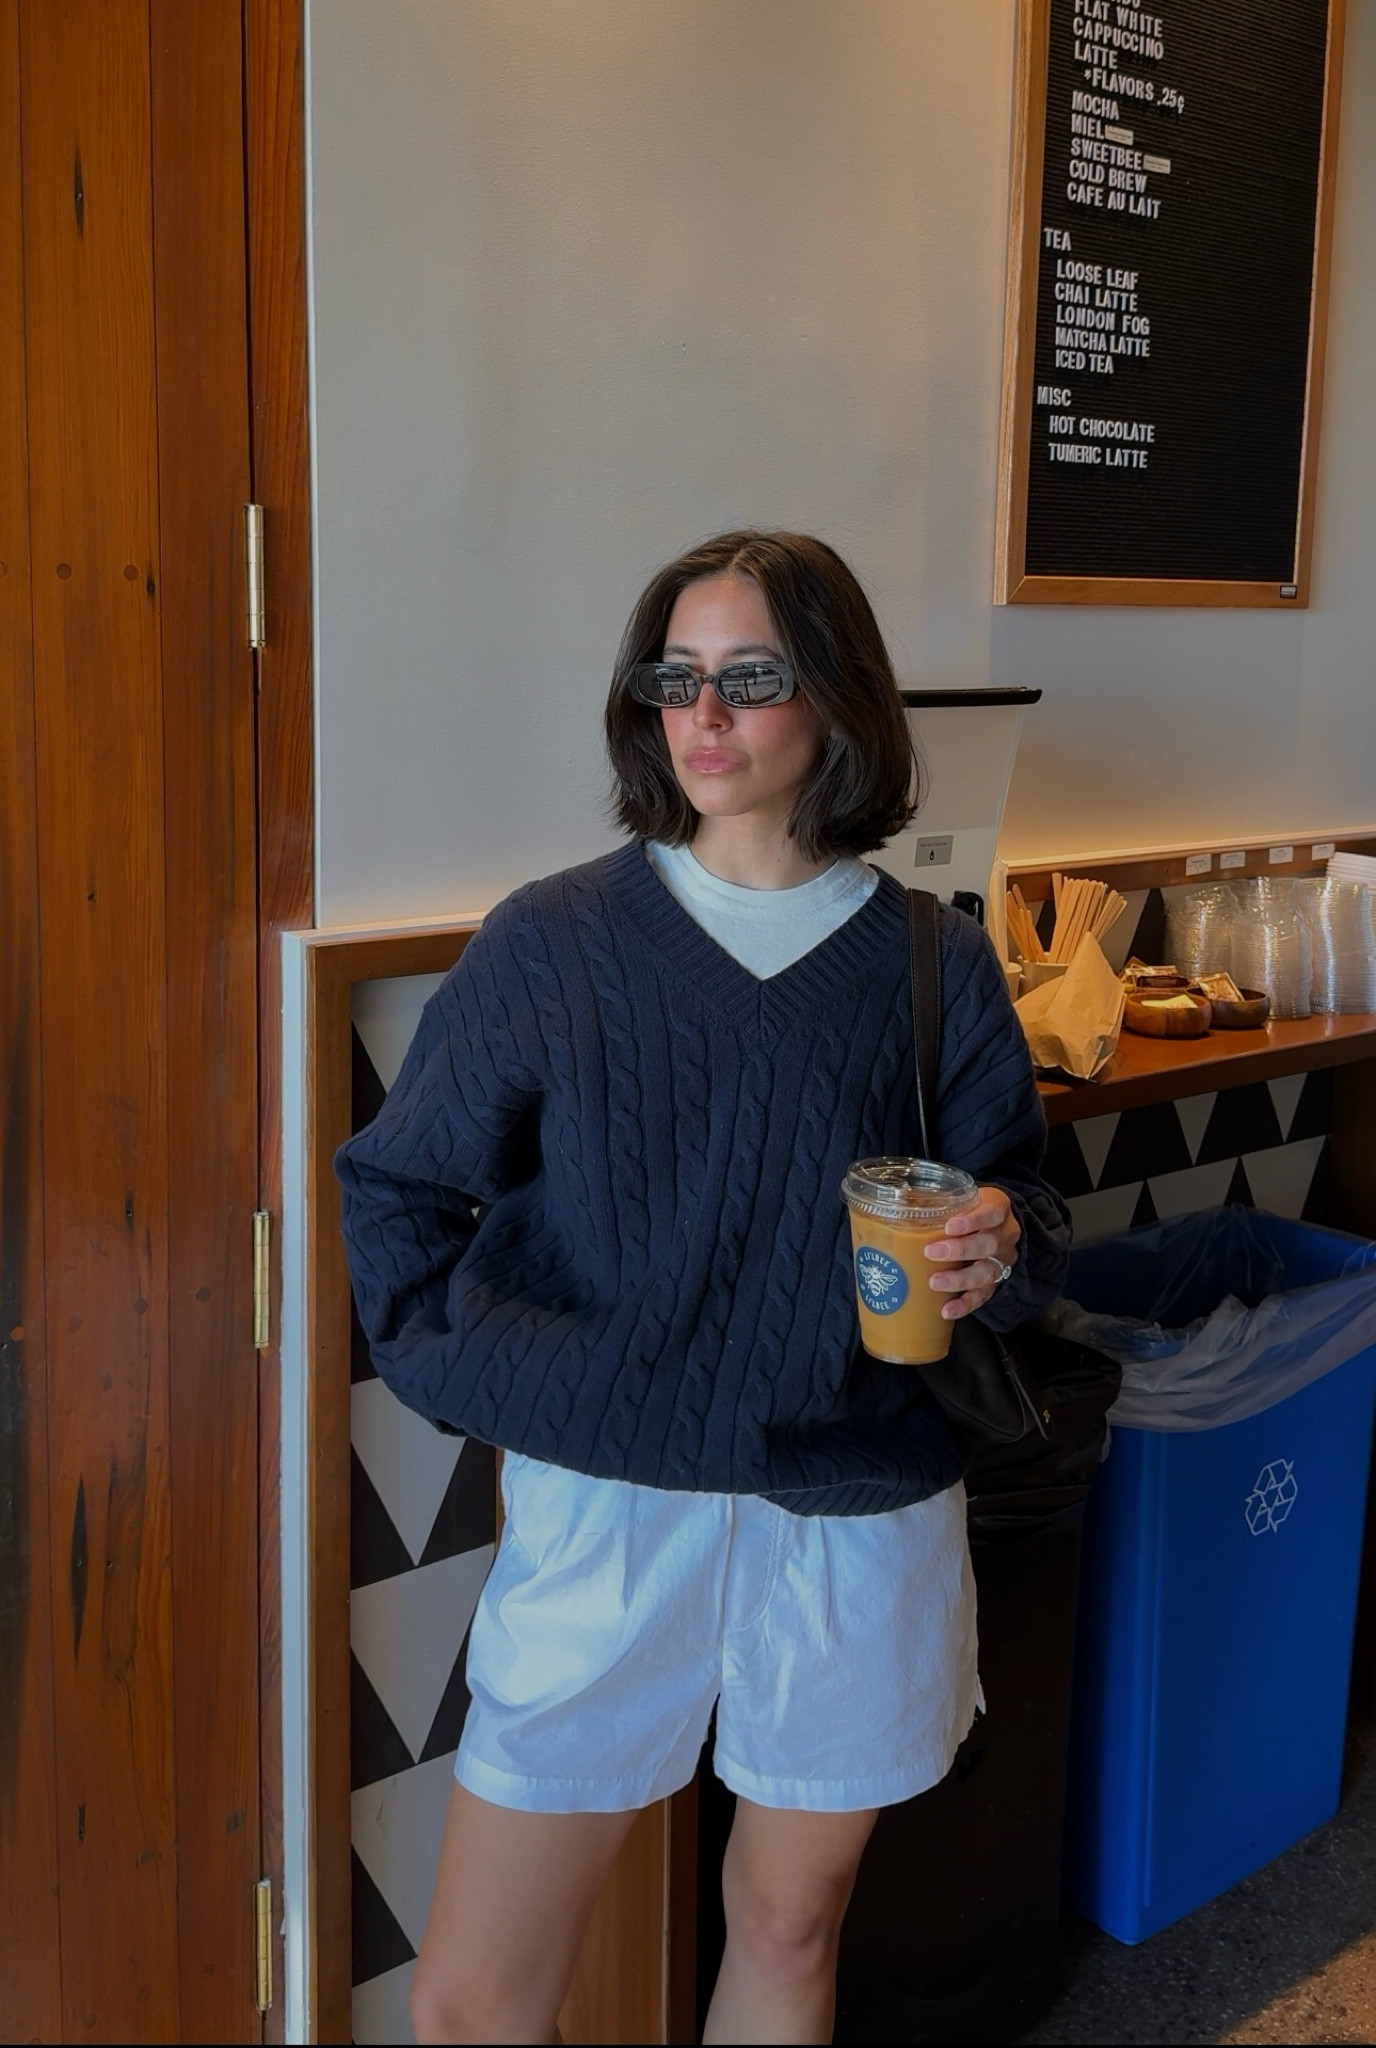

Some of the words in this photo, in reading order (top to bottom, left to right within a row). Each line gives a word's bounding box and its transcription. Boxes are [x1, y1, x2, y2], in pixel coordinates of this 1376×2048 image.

[1075, 0, 1109, 21] FLAT
[1117, 6, 1162, 37] WHITE
[1073, 17, 1163, 59] CAPPUCCINO
[1075, 41, 1118, 70] LATTE
[1072, 91, 1119, 120] MOCHA
[1071, 114, 1104, 139] MIEL
[1071, 138, 1142, 170] SWEETBEE
[1069, 160, 1104, 183] COLD
[1109, 170, 1147, 193] BREW
[1067, 183, 1103, 207] CAFE
[1108, 191, 1125, 211] AU
[1129, 196, 1161, 219] LAIT
[1044, 228, 1071, 250] TEA
[1057, 259, 1102, 284] LOOSE
[1107, 268, 1138, 290] LEAF
[1055, 283, 1089, 303] CHAI
[1096, 289, 1138, 312] LATTE
[1057, 305, 1115, 331] LONDON
[1122, 315, 1150, 335] FOG
[1055, 327, 1107, 351] MATCHA
[1110, 334, 1150, 357] LATTE
[1055, 350, 1085, 370] ICED
[1089, 354, 1114, 373] TEA
[1037, 386, 1072, 407] MISC
[1049, 415, 1076, 434] HOT
[1079, 419, 1155, 443] CHOCOLATE
[1049, 443, 1101, 463] TUMERIC
[1105, 448, 1148, 468] LATTE
